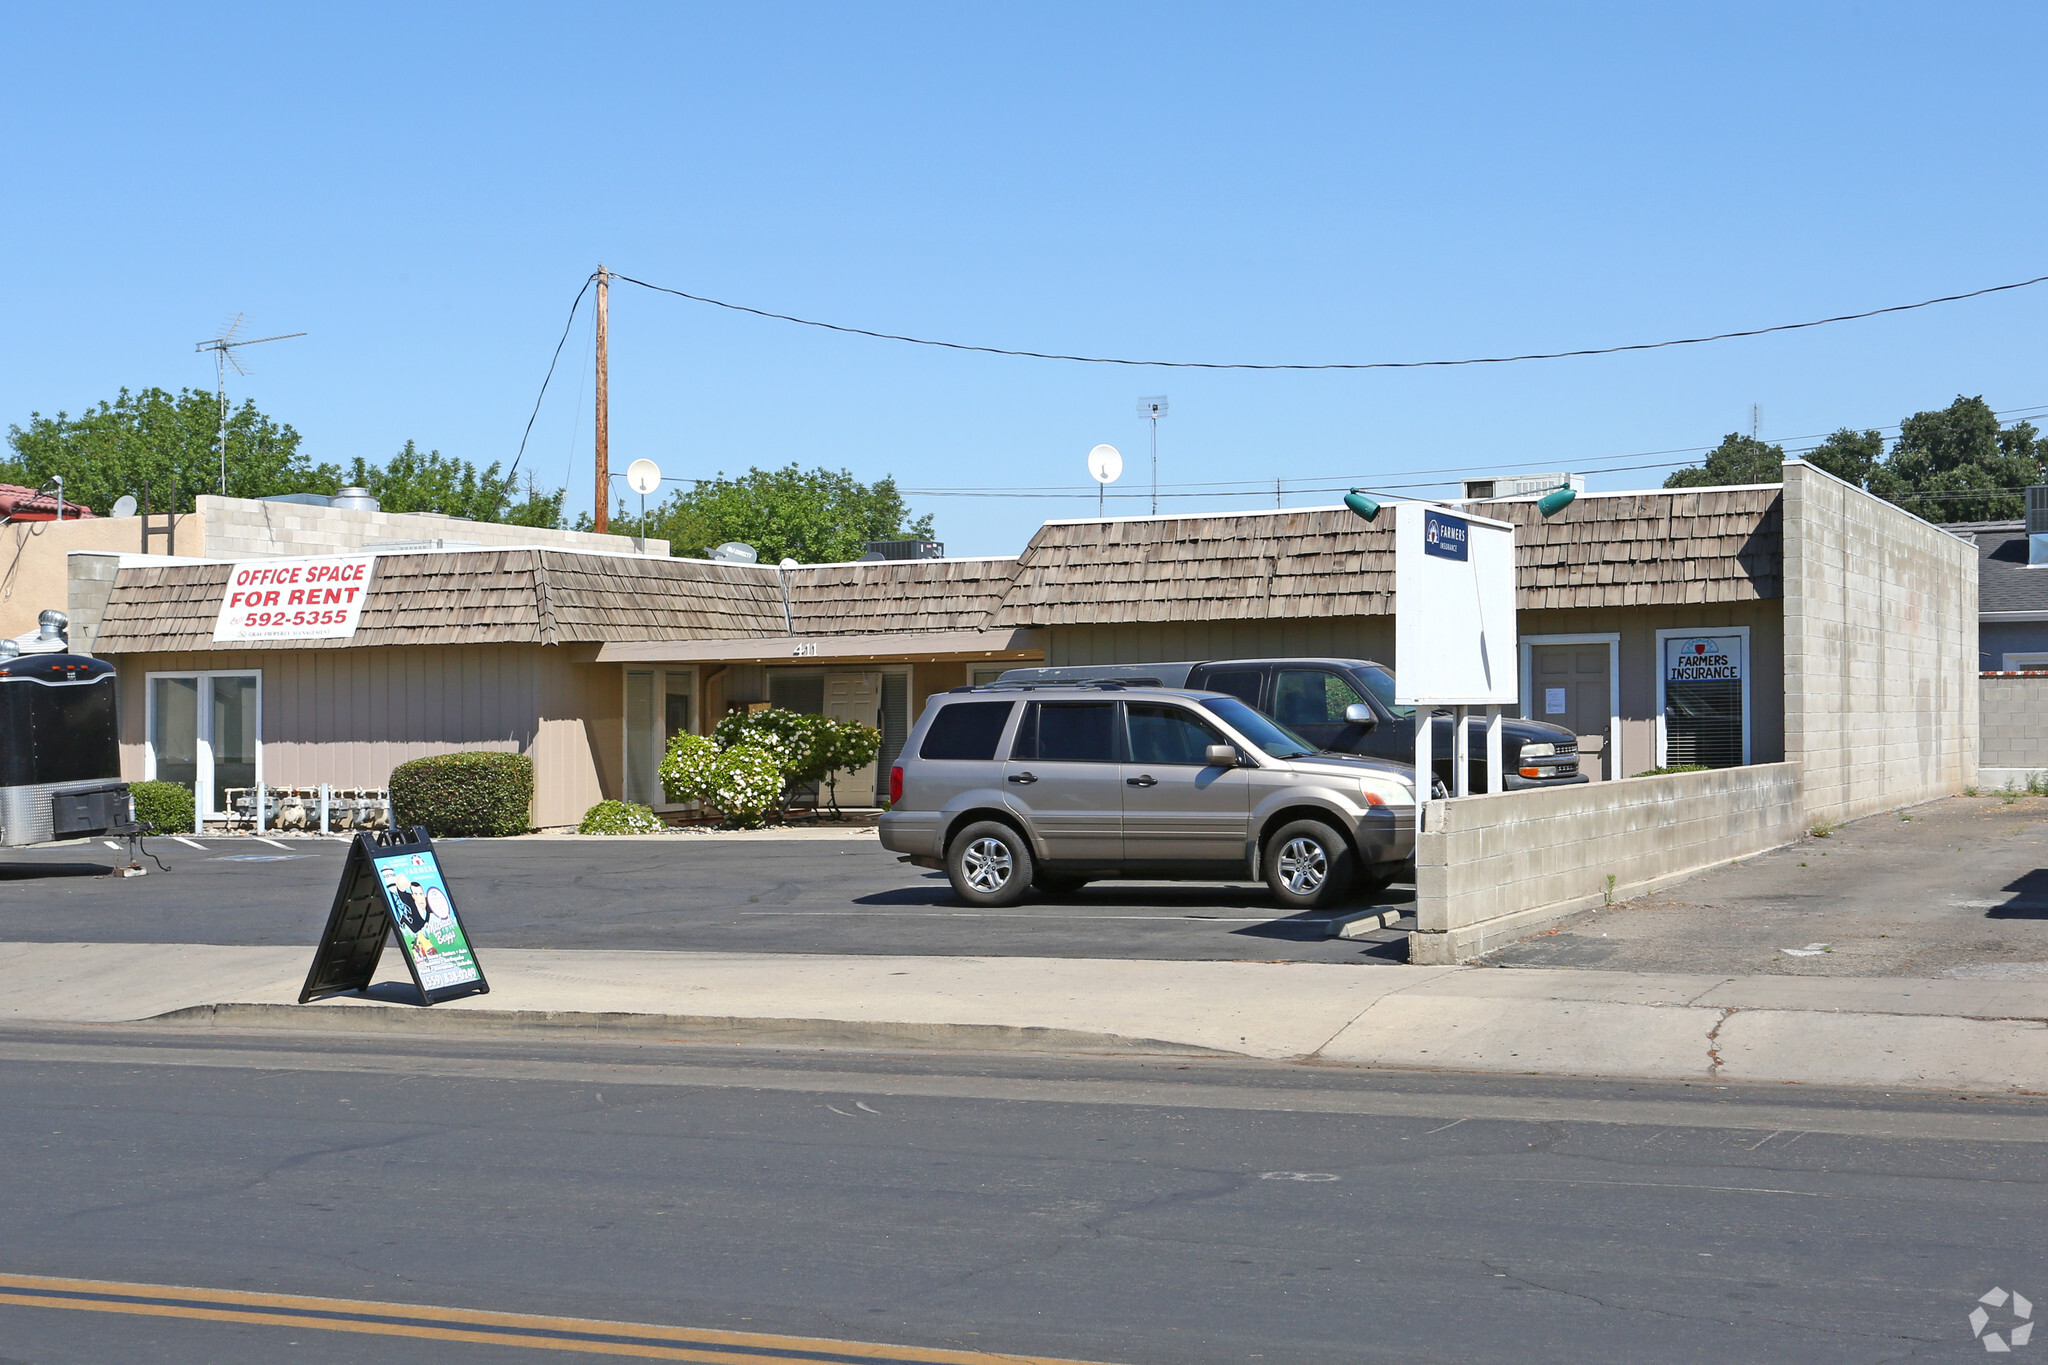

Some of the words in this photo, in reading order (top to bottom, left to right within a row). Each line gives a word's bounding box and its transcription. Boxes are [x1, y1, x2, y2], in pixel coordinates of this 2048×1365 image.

[1440, 524, 1465, 542] FARMERS
[1440, 542, 1458, 552] INSURANCE
[237, 567, 302, 586] OFFICE
[306, 564, 366, 583] SPACE
[230, 591, 280, 608] FOR
[288, 587, 359, 605] RENT
[244, 610, 347, 627] 592-5355
[793, 642, 817, 657] 411
[1678, 655, 1728, 667] FARMERS
[1671, 667, 1737, 680] INSURANCE
[404, 865, 437, 875] FARMERS
